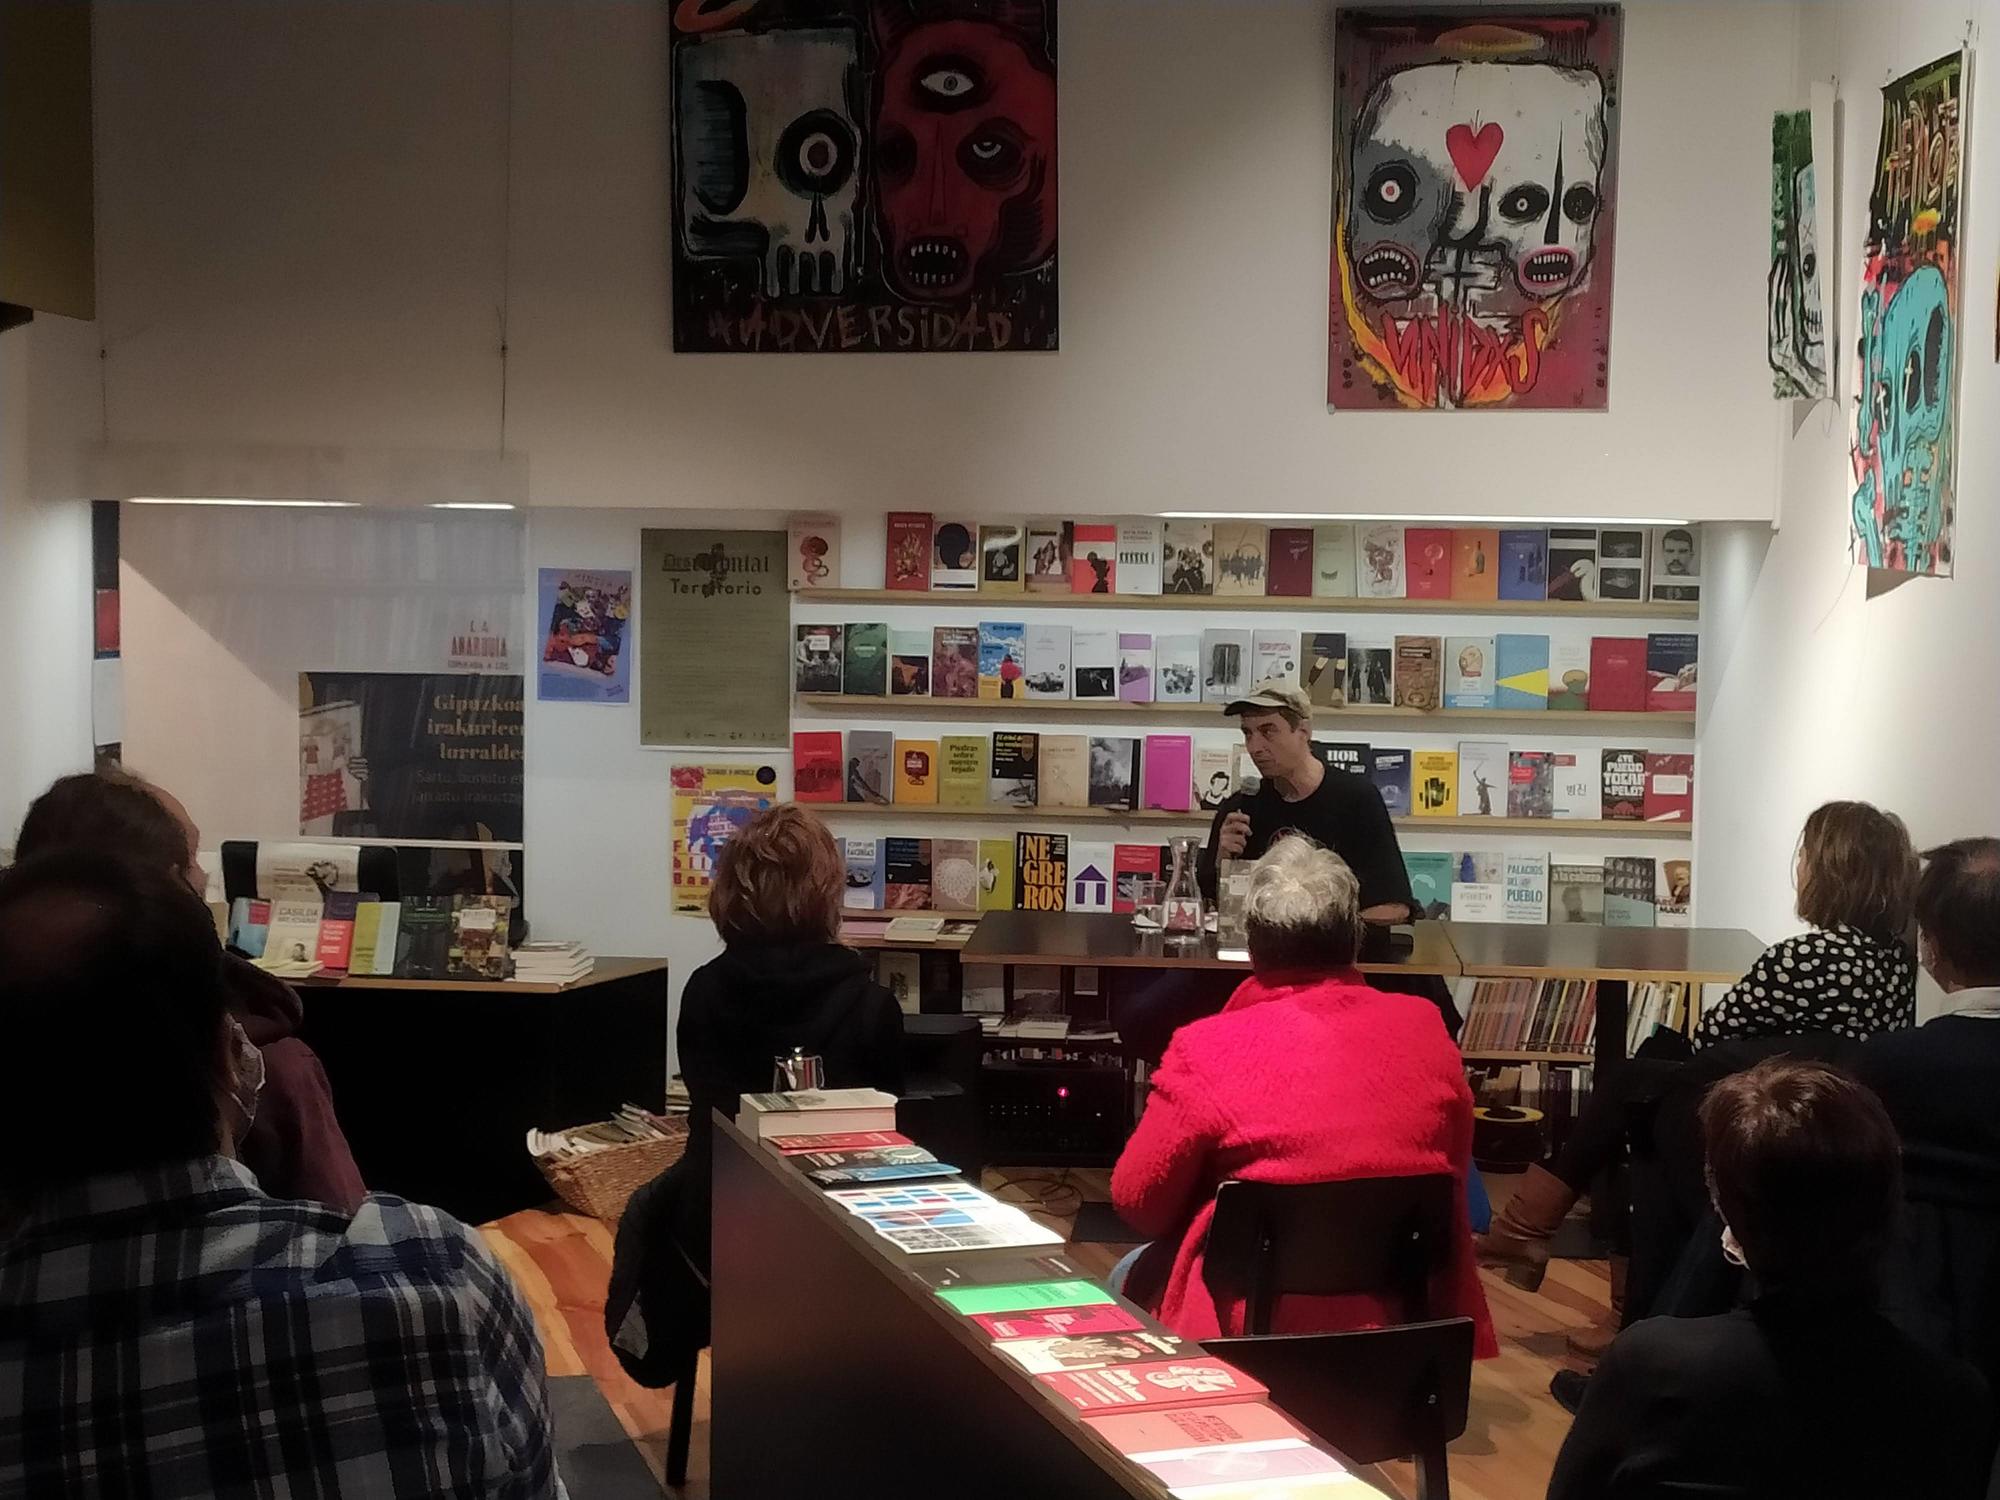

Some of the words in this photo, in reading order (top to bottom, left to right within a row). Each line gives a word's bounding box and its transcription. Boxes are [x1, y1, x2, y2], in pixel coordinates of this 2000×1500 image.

[1024, 835, 1050, 860] NE
[1023, 860, 1065, 886] GRE
[1507, 864, 1543, 875] PALACIOS
[1023, 885, 1065, 911] ROS
[1507, 890, 1543, 902] PUEBLO
